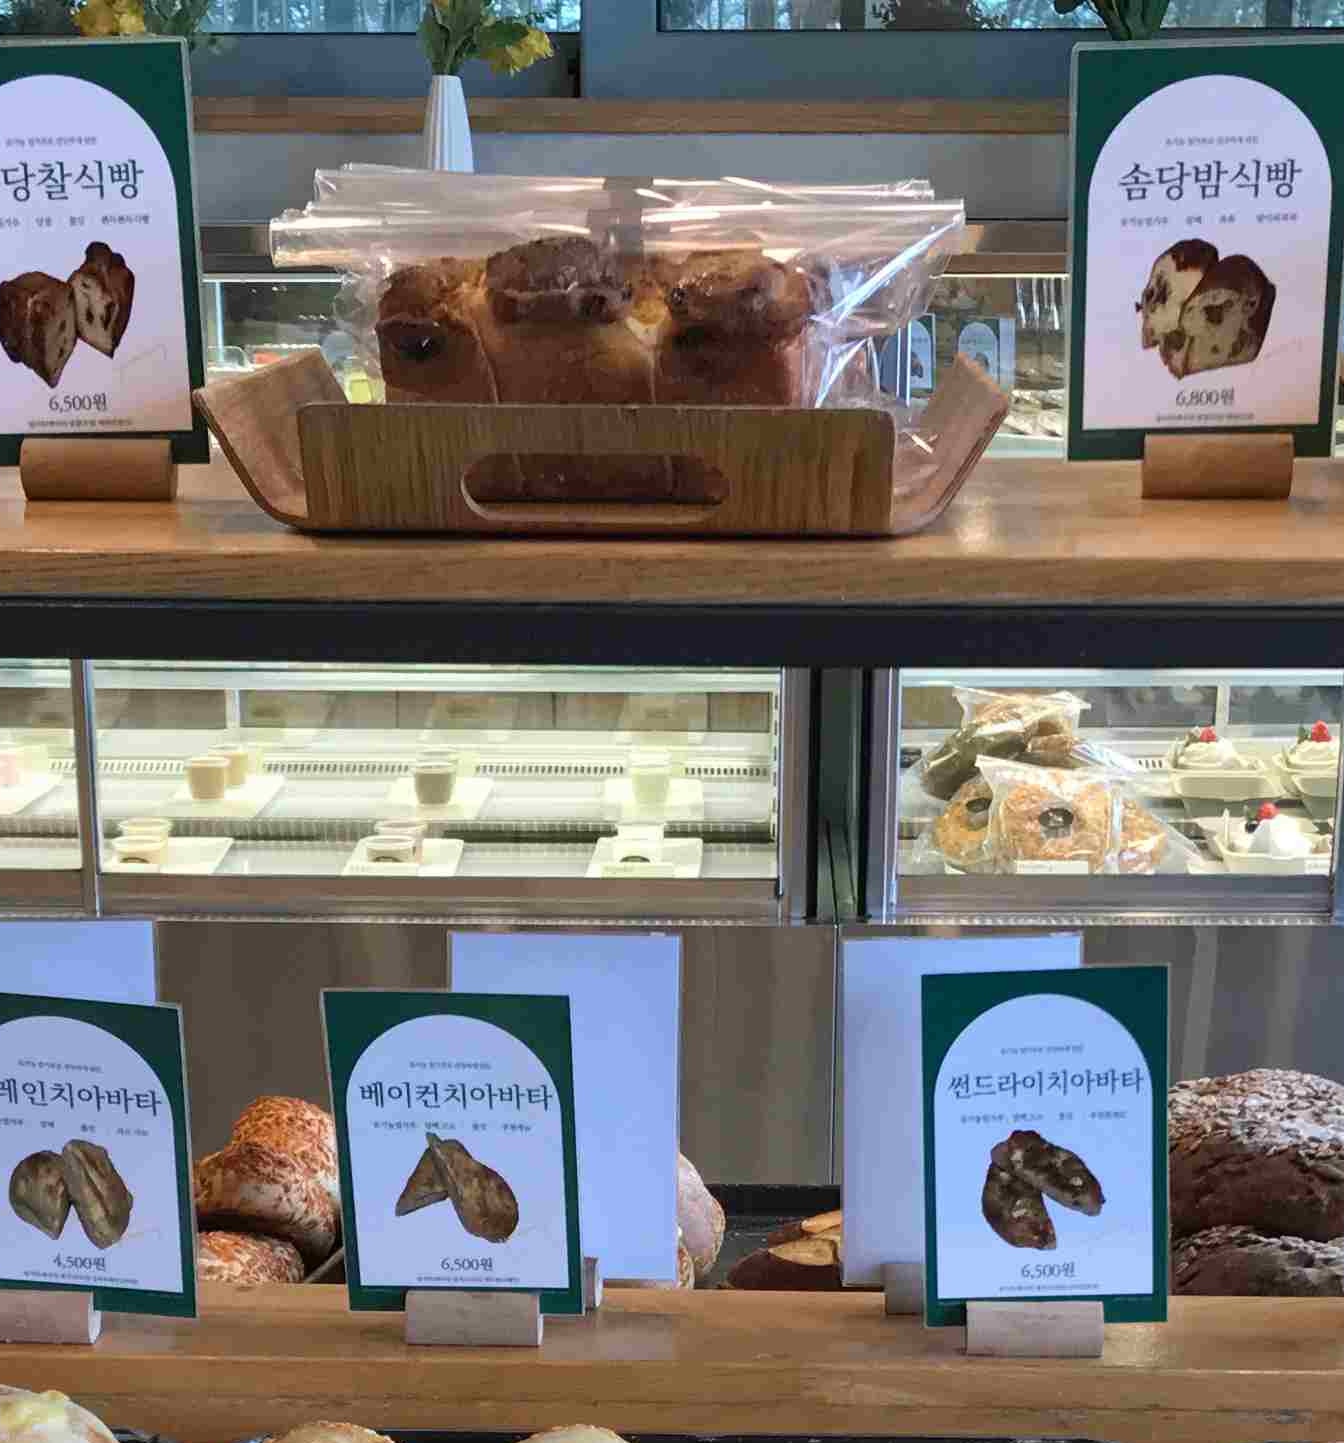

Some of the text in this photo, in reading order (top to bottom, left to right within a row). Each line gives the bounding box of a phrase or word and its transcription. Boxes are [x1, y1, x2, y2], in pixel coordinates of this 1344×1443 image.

[1118, 158, 1303, 201] 솜당밤식빵
[48, 393, 107, 413] 6,500원
[947, 1067, 1145, 1099] 썬드라이치아바타
[359, 1080, 553, 1112] 베이컨치아바타
[52, 1256, 107, 1272] 4,500원
[440, 1257, 494, 1273] 6,500원
[1020, 1261, 1077, 1280] 6,500원
